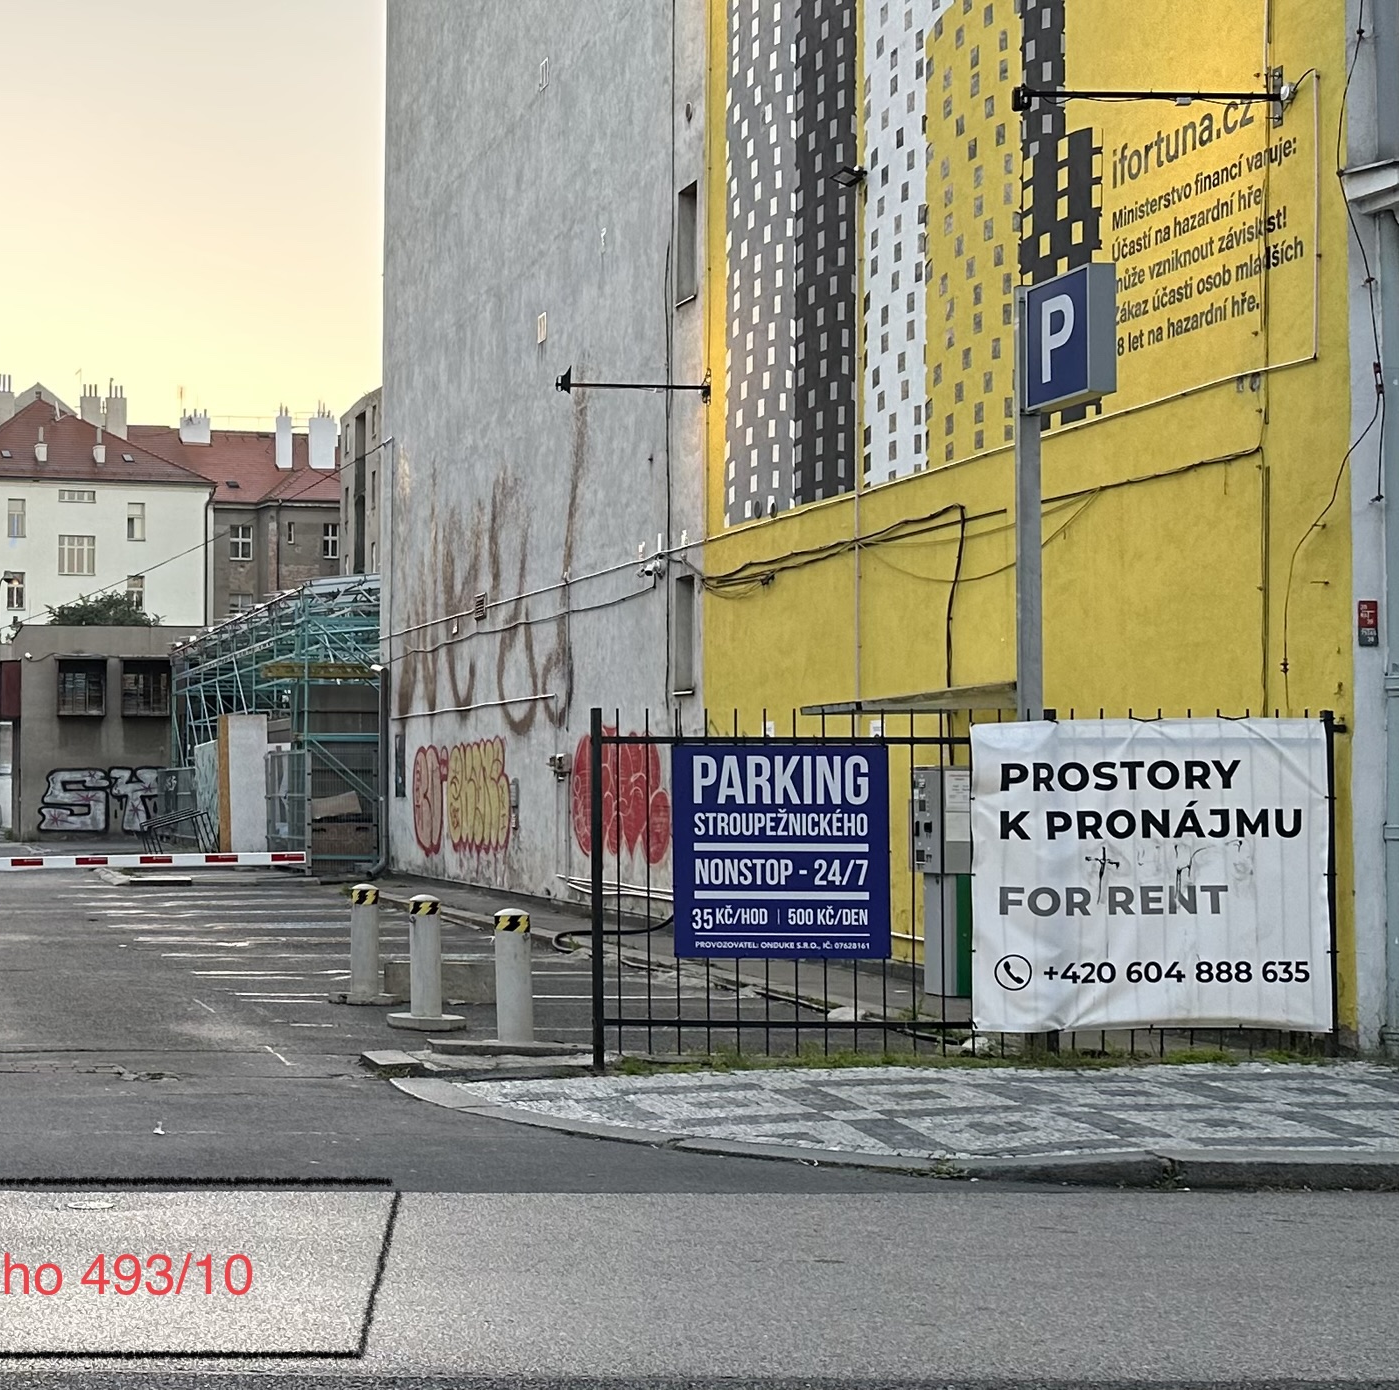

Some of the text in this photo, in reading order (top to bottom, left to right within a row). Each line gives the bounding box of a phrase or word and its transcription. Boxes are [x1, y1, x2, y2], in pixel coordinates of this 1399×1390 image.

[1111, 99, 1255, 190] ifortuna.cz
[1111, 182, 1192, 232] Ministerstvo
[1194, 153, 1244, 196] financí
[1111, 226, 1153, 263] Účastí
[1154, 225, 1171, 245] na
[1173, 191, 1235, 239] hazardní
[1148, 236, 1215, 280] vzniknout
[1152, 277, 1193, 312] účasti
[1196, 264, 1232, 295] osob
[1235, 236, 1304, 282] mladších
[1041, 293, 1075, 384] P
[1116, 291, 1260, 356] 8 let na hazardní hře.
[692, 754, 870, 805] PARKING
[1000, 759, 1242, 792] PROSTORY
[693, 808, 869, 836] STROUPEŽNICKÉHO
[999, 800, 1303, 840] K PRONÁJMU
[694, 859, 793, 885] NONSTOP
[813, 859, 869, 886] 24/7
[691, 905, 869, 930] 35 KČ/HOD 500 KČ/DEN
[998, 885, 1229, 917] FOR RENT
[694, 941, 759, 949] PROVOZOVATEL:
[760, 942, 795, 950] ONDUKE
[1043, 960, 1310, 984] +420 604 888 635
